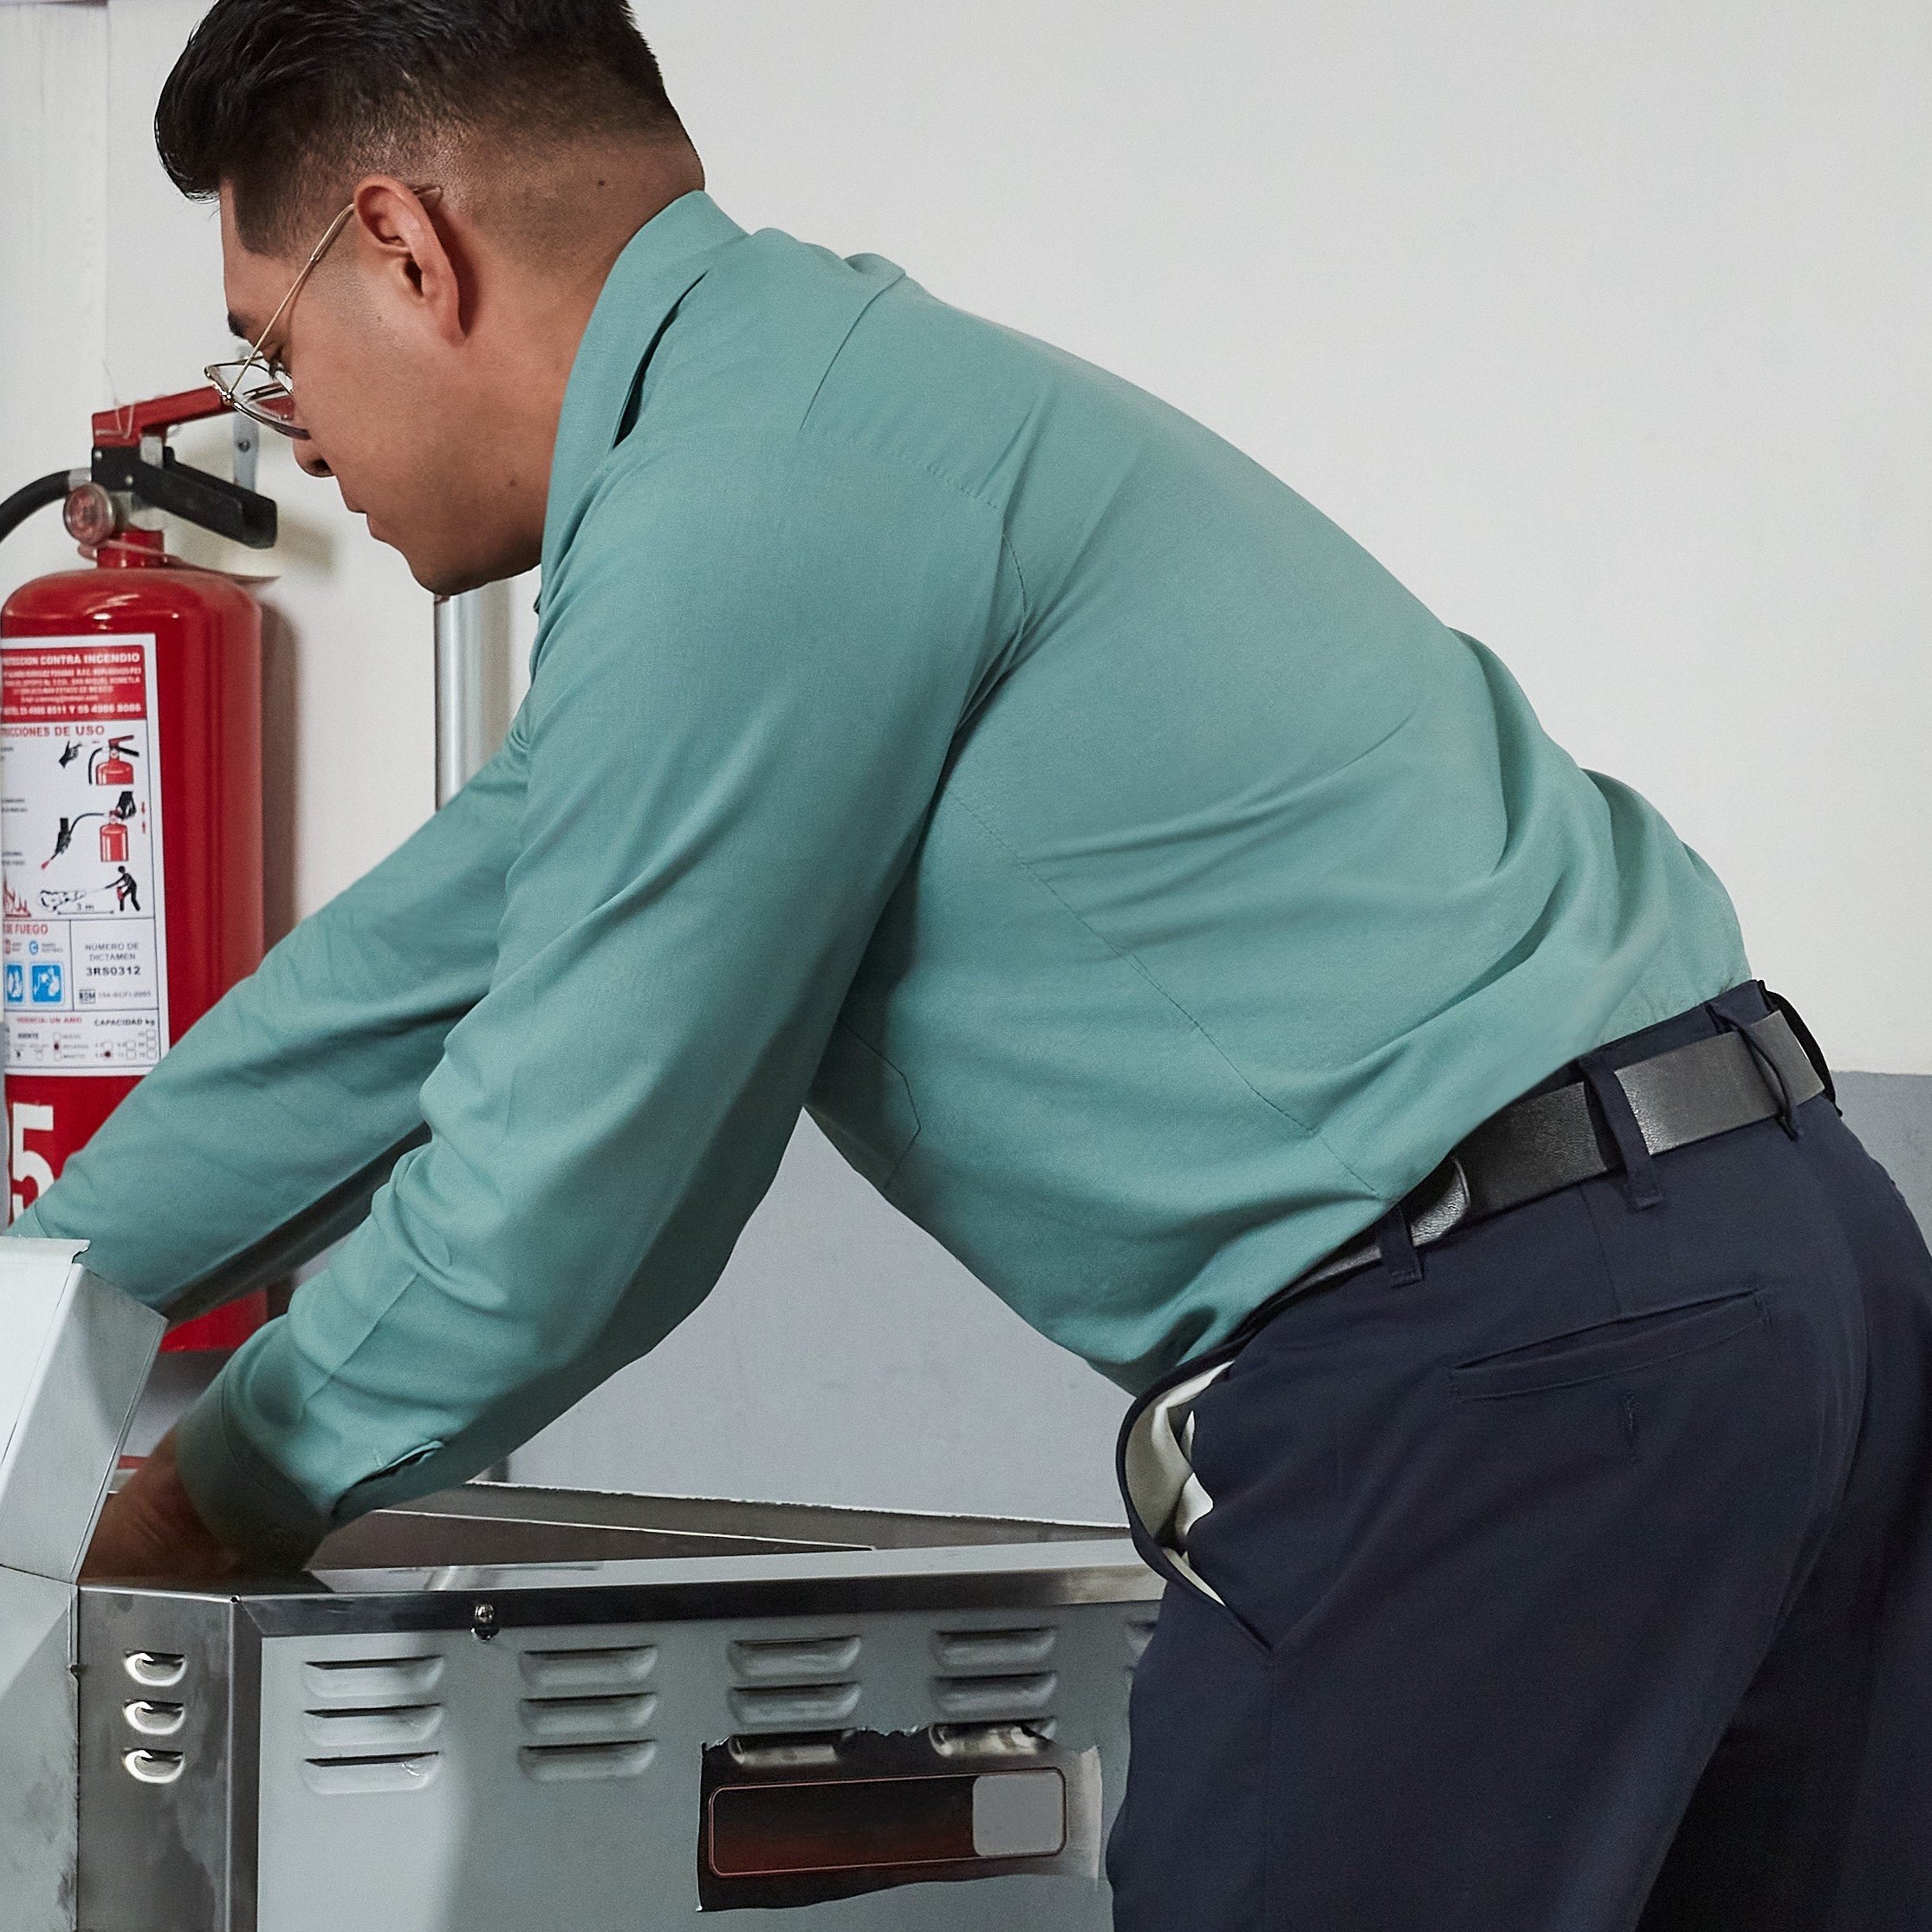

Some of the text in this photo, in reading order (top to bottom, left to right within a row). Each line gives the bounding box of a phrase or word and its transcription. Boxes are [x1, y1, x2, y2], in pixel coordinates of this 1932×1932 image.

[41, 654, 81, 665] CONTRA
[83, 652, 140, 664] INCENDIO
[68, 704, 75, 715] Y
[55, 726, 70, 736] DE
[75, 725, 105, 736] USO
[76, 903, 81, 911] 3
[15, 924, 49, 935] FUEGO
[89, 953, 136, 962] DICTAMEN
[86, 965, 141, 976] 3RS0312
[145, 1018, 155, 1027] kg
[12, 1102, 55, 1222] 5
